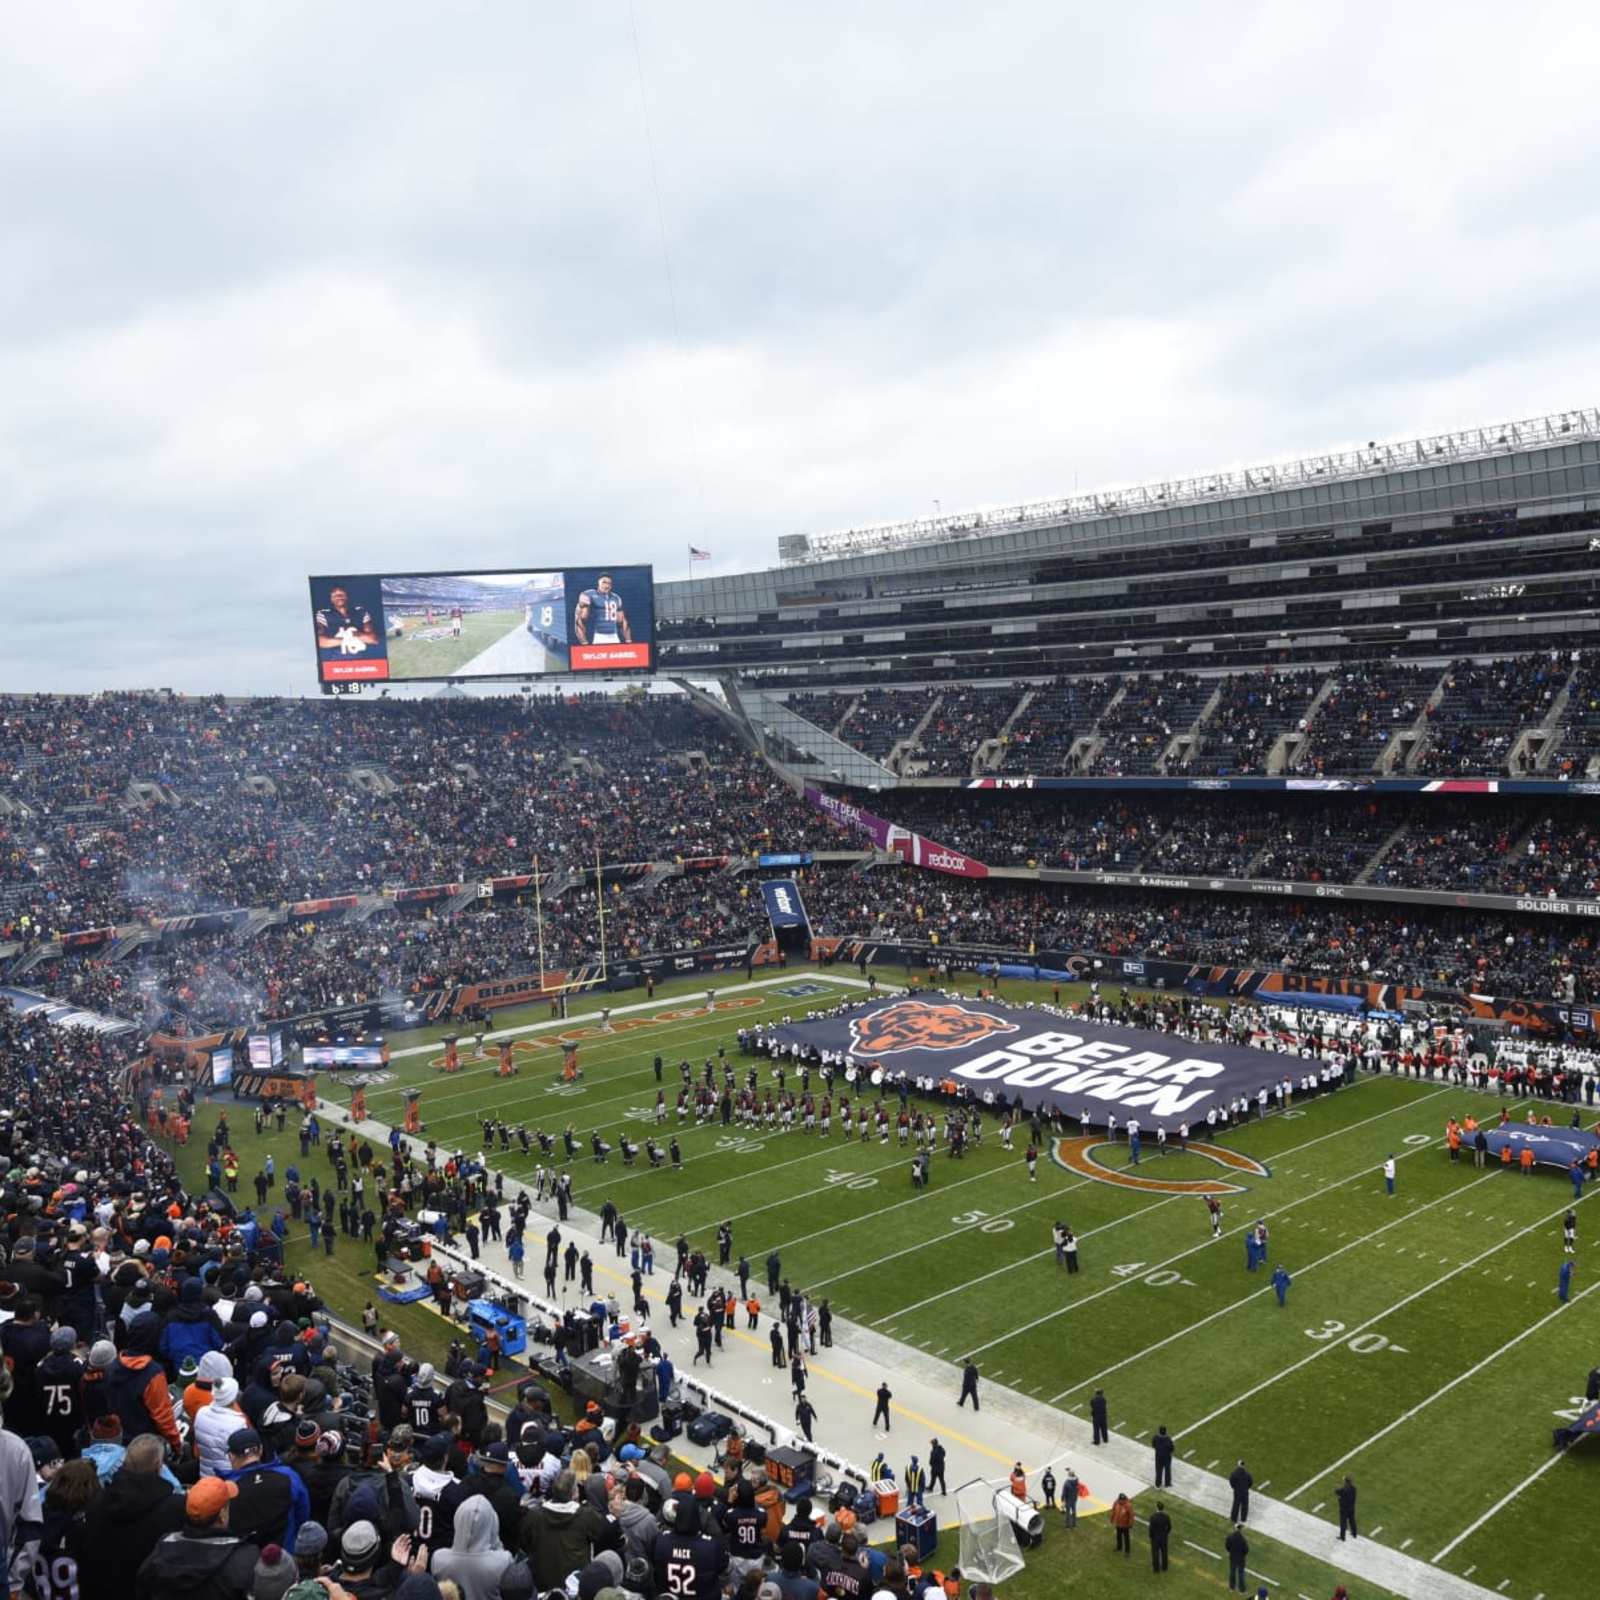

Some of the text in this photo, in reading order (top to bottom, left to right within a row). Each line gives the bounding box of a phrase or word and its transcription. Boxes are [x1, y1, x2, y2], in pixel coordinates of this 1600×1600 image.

[604, 601, 617, 621] 18
[820, 793, 861, 821] BEST DEAL
[928, 851, 966, 871] redbox
[1149, 879, 1189, 887] Advocate
[1326, 887, 1345, 897] PNC
[1516, 900, 1569, 914] SOLDIER
[478, 979, 541, 999] BEARS
[1007, 1031, 1225, 1085] BEAR
[950, 1050, 1215, 1117] DOWN
[824, 1168, 878, 1189] 40
[952, 1210, 1015, 1234] 50
[1111, 1262, 1182, 1287] 40
[1304, 1319, 1390, 1353] 30
[43, 1385, 71, 1415] 75
[415, 1407, 429, 1426] 10
[738, 1526, 756, 1543] 90
[672, 1548, 690, 1559] MACK
[667, 1563, 696, 1595] 52
